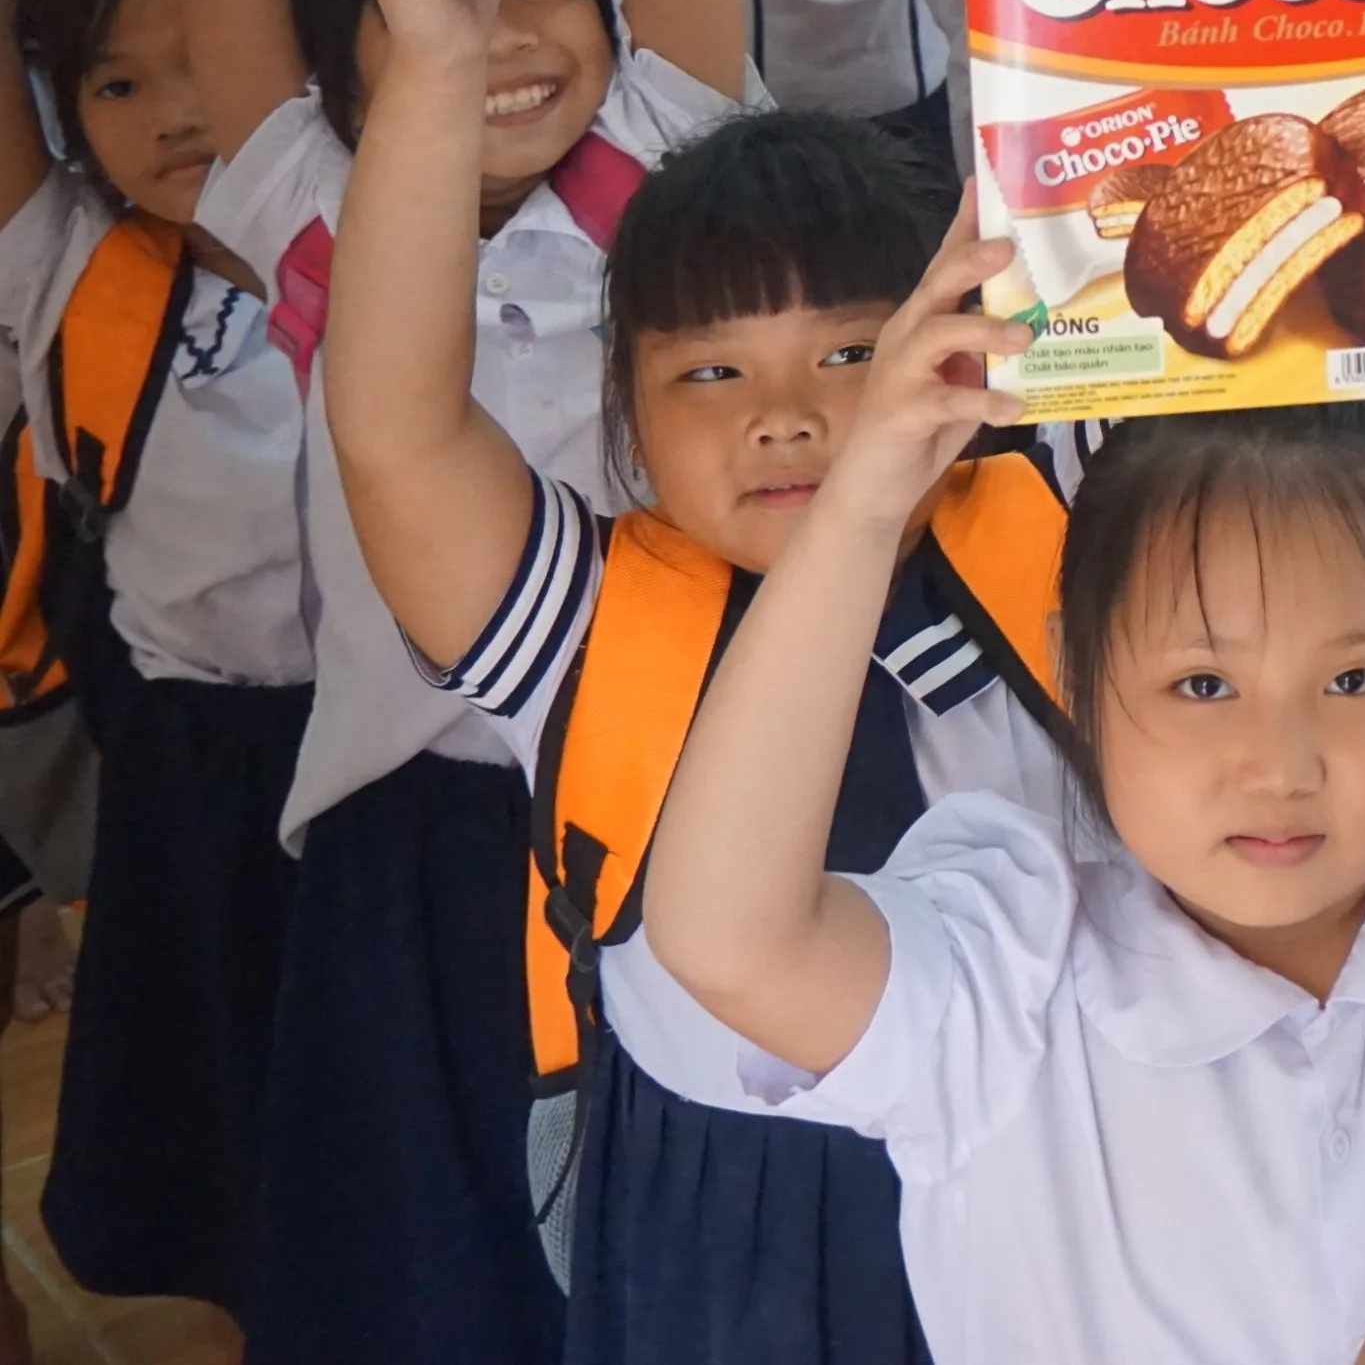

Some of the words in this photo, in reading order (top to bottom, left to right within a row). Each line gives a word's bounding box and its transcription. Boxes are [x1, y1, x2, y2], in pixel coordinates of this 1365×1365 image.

[1157, 18, 1238, 48] Bánh
[1083, 102, 1155, 138] ORION
[1034, 112, 1201, 188] Choco·Pie
[1037, 312, 1100, 336] HÔNG
